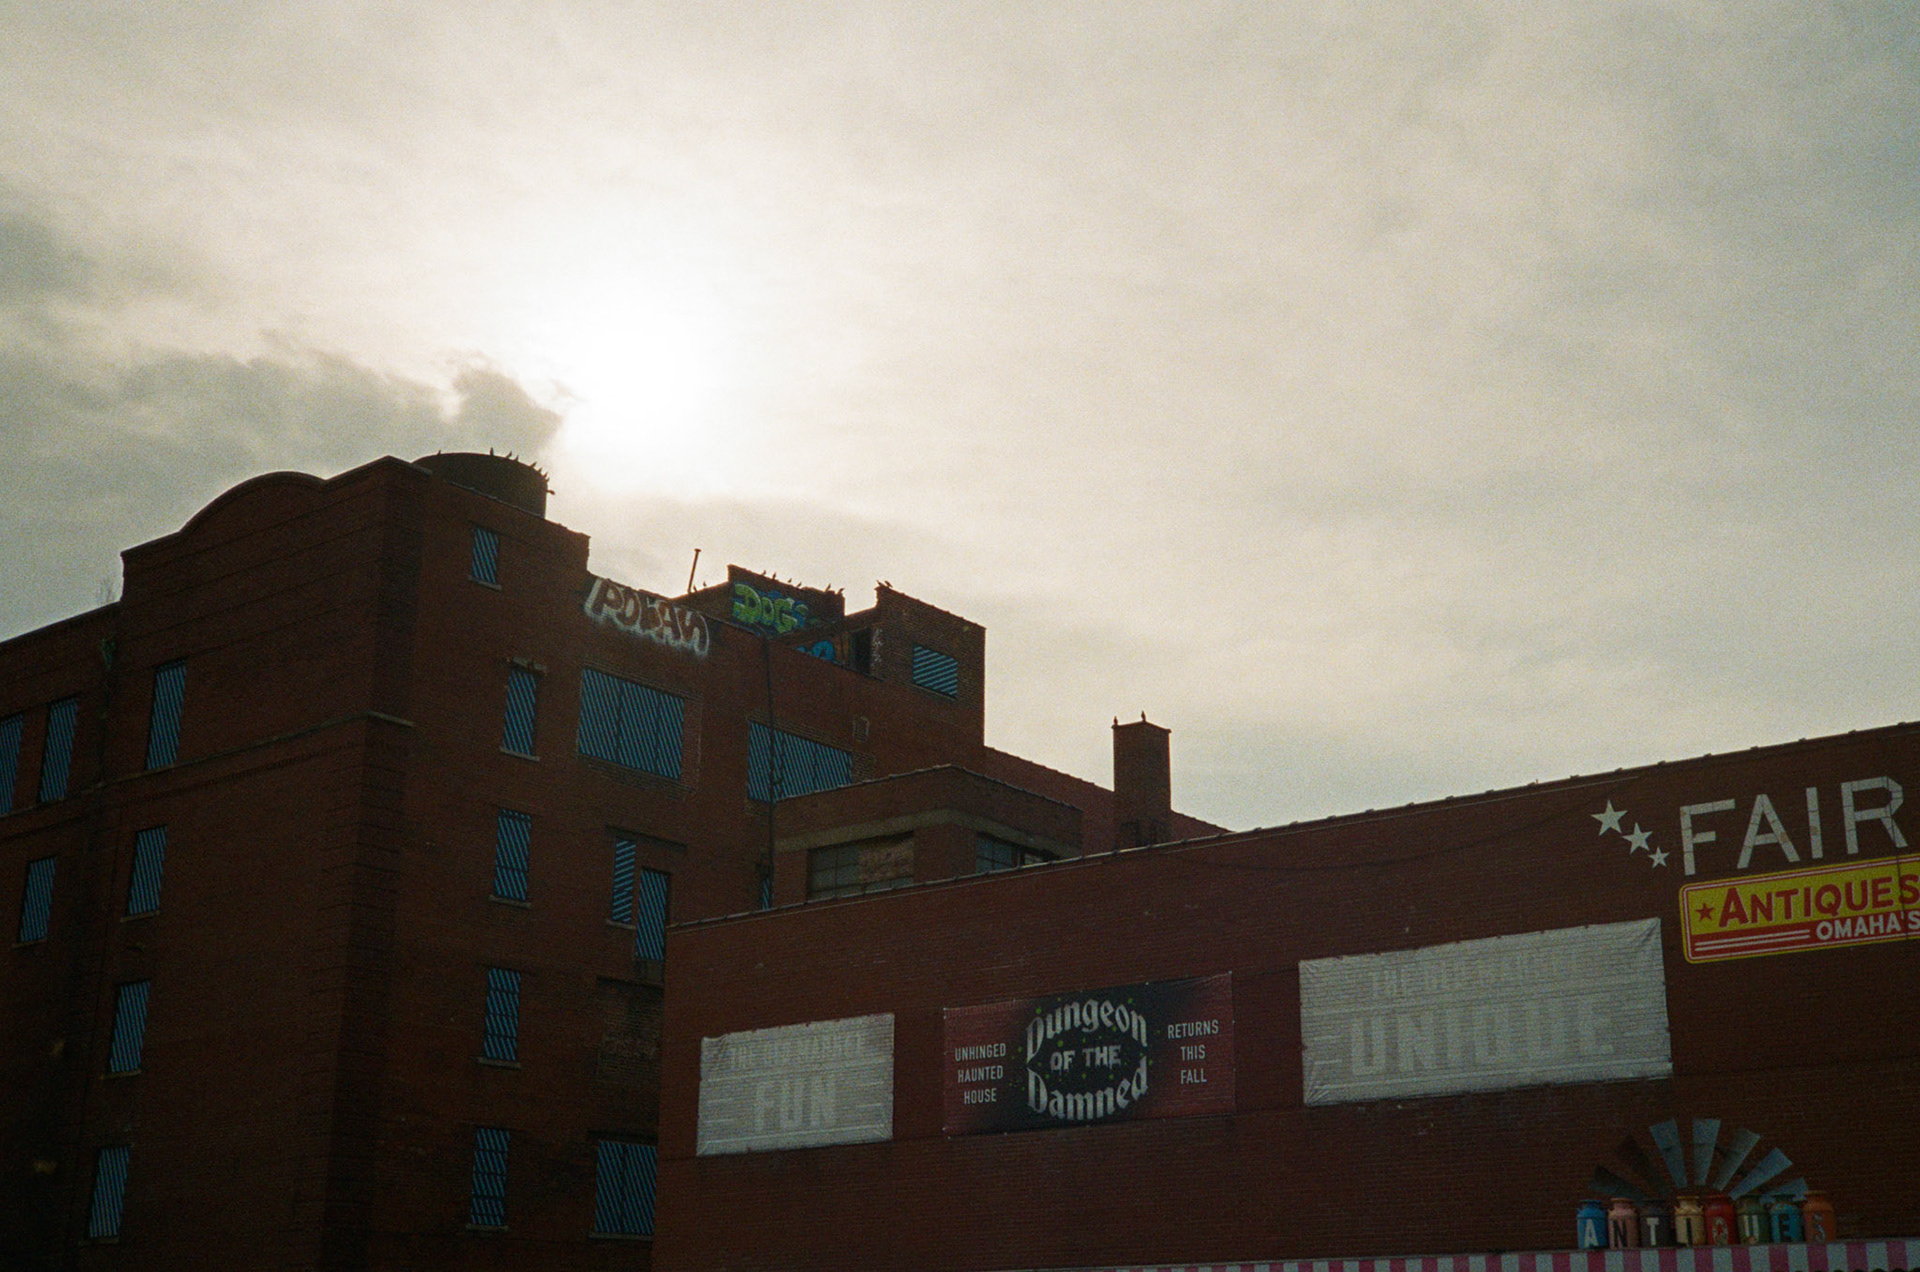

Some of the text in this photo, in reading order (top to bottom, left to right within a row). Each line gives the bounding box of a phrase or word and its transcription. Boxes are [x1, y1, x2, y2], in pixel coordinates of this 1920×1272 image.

[1680, 776, 1908, 876] FAIR
[1719, 874, 1920, 927] ANTIQUES
[1816, 911, 1920, 940] OMAHA'S
[1026, 999, 1148, 1062] Dungeon
[1167, 1019, 1220, 1040] RETURNS
[1349, 993, 1614, 1075] UNIQUE
[955, 1043, 1007, 1062] UNHINGED
[1050, 1045, 1122, 1073] OF THE
[1180, 1045, 1206, 1061] THIS
[957, 1065, 1004, 1084] HAUNTED
[1027, 1056, 1149, 1121] Damned
[1180, 1068, 1207, 1085] FALL
[754, 1073, 836, 1132] FUN
[963, 1088, 997, 1105] HOUSE
[1584, 1213, 1826, 1248] ANTIQUES
